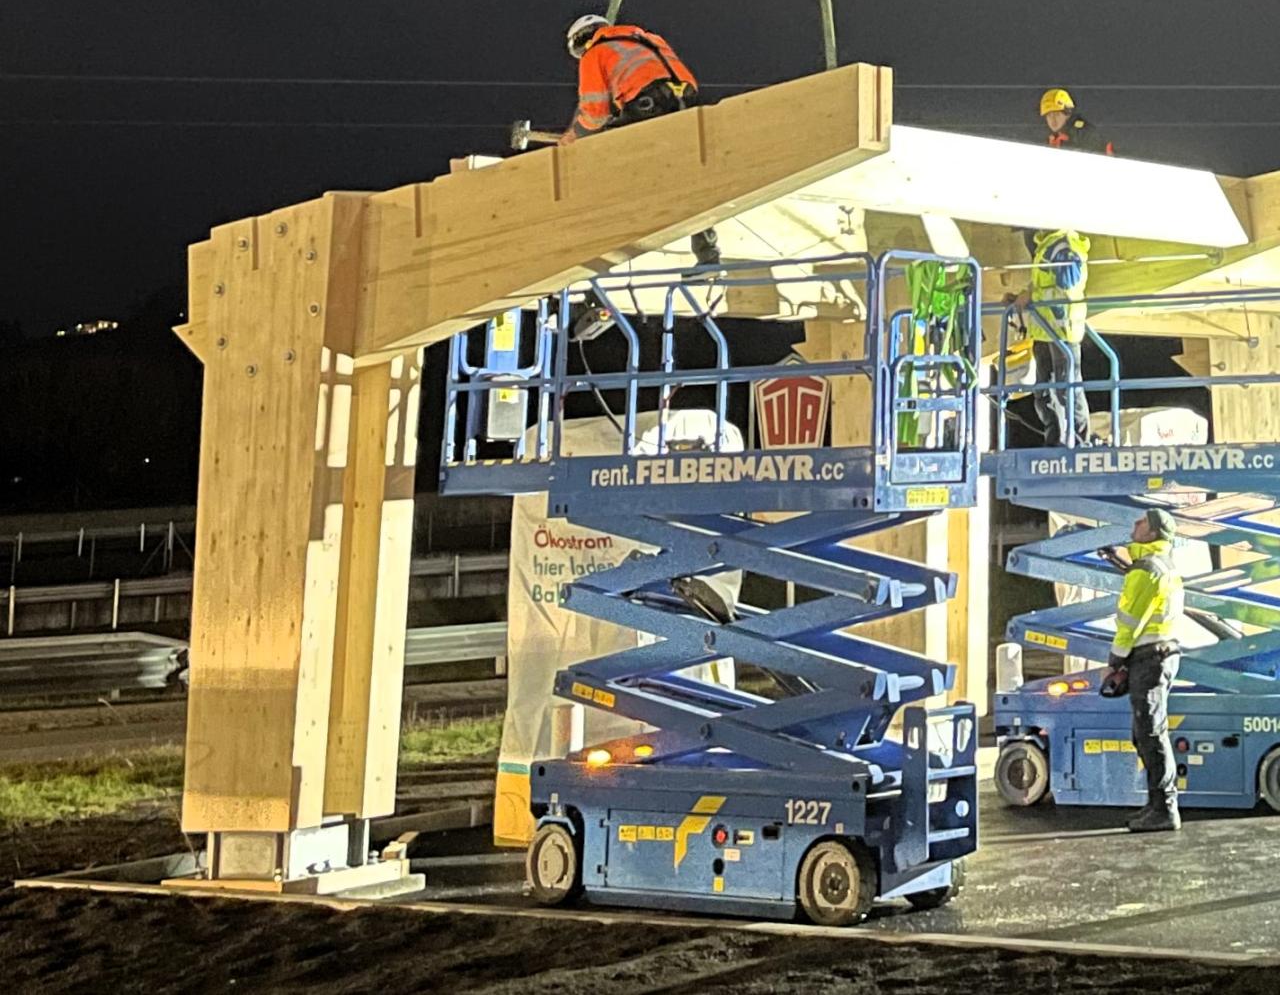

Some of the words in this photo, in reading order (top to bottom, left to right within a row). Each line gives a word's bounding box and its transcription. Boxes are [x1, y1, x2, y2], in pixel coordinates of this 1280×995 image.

[763, 377, 822, 445] UTA
[591, 454, 844, 486] rent.FELBERMAYR.cc
[1031, 447, 1274, 475] rent.FELBERMAYR.cc
[534, 524, 613, 550] Ökostrom
[533, 554, 565, 575] hier
[785, 799, 832, 824] 1227
